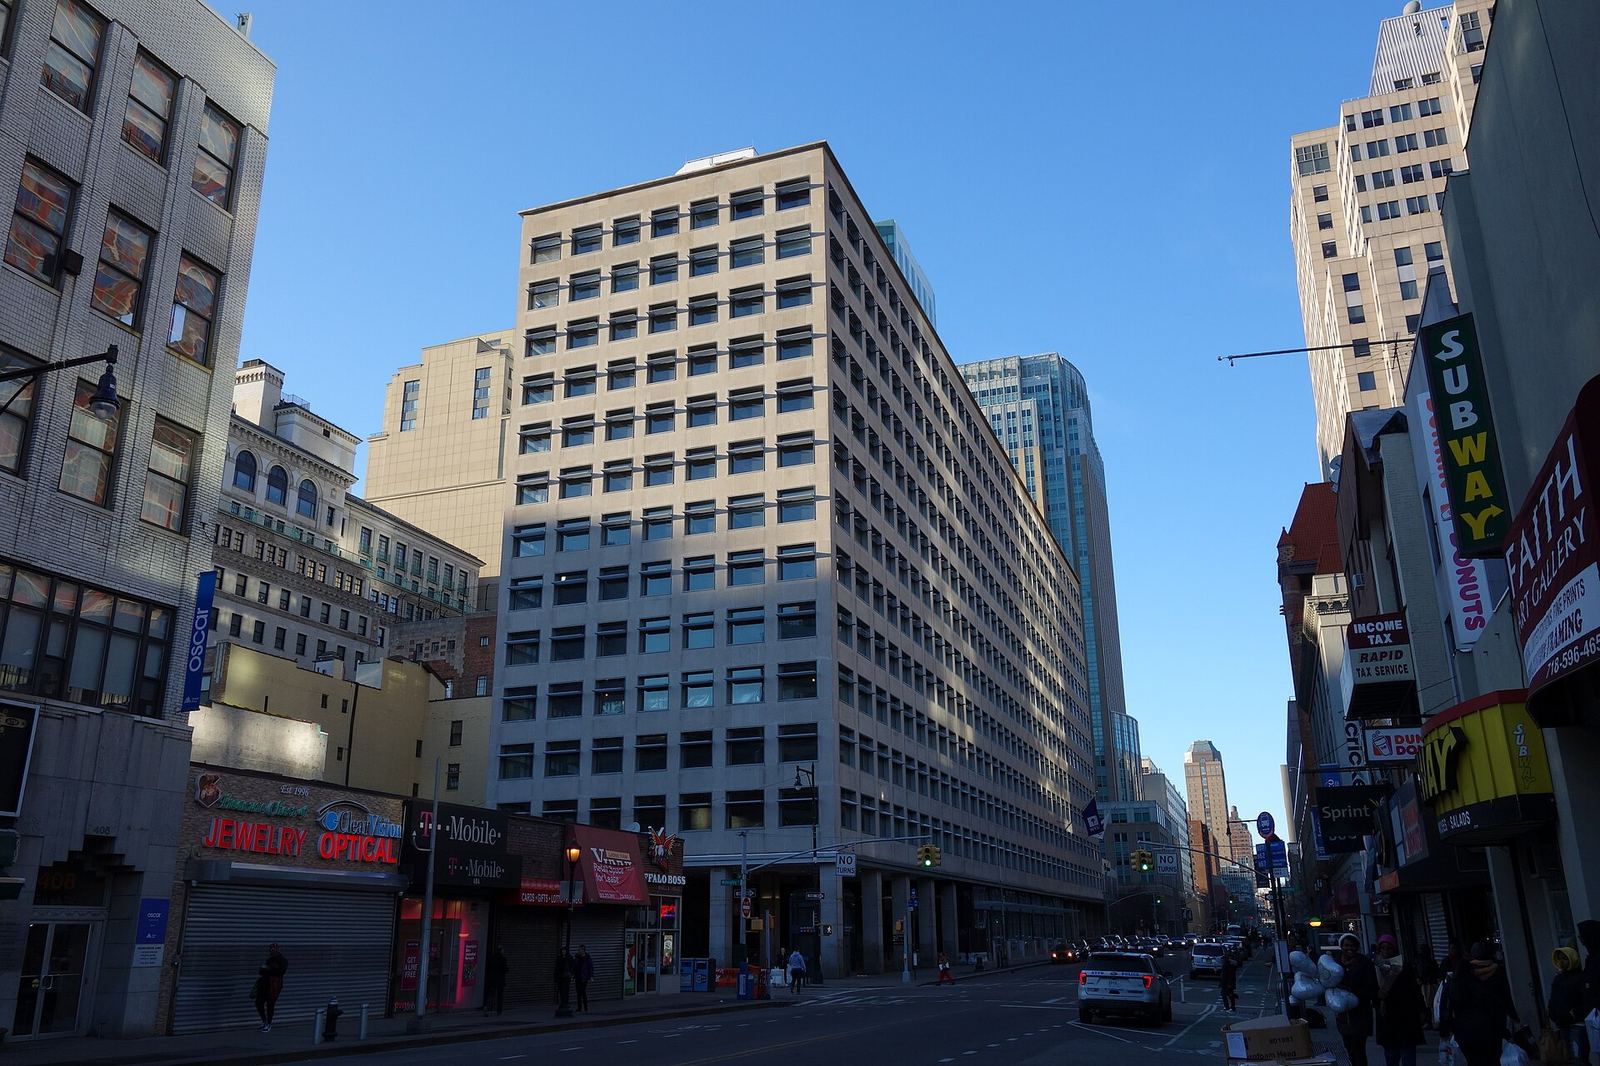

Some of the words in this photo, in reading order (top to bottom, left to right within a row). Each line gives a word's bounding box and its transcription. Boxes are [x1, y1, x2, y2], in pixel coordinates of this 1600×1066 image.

[1434, 329, 1504, 541] SUBWAY
[1504, 433, 1583, 599] FAITH
[1531, 505, 1586, 607] GALLERY
[1353, 619, 1404, 634] INCOME
[188, 607, 209, 672] oscar
[1367, 633, 1393, 645] TAX
[1360, 650, 1404, 663] RAPID
[1356, 667, 1372, 678] TAX
[1374, 664, 1409, 677] SERVICE
[1513, 723, 1537, 790] SUBWAY
[1321, 804, 1373, 822] Sprint
[1449, 811, 1472, 830] SALADS
[204, 816, 308, 857] JEWELRY
[319, 831, 399, 865] OPTICAL
[838, 855, 853, 865] NO
[1159, 855, 1174, 865] NO
[837, 867, 855, 875] TURNS
[1158, 865, 1178, 874] TURNS
[668, 874, 687, 886] BOSS
[521, 892, 535, 903] CARDS
[537, 893, 548, 904] GIFTS
[146, 911, 161, 919] oscar
